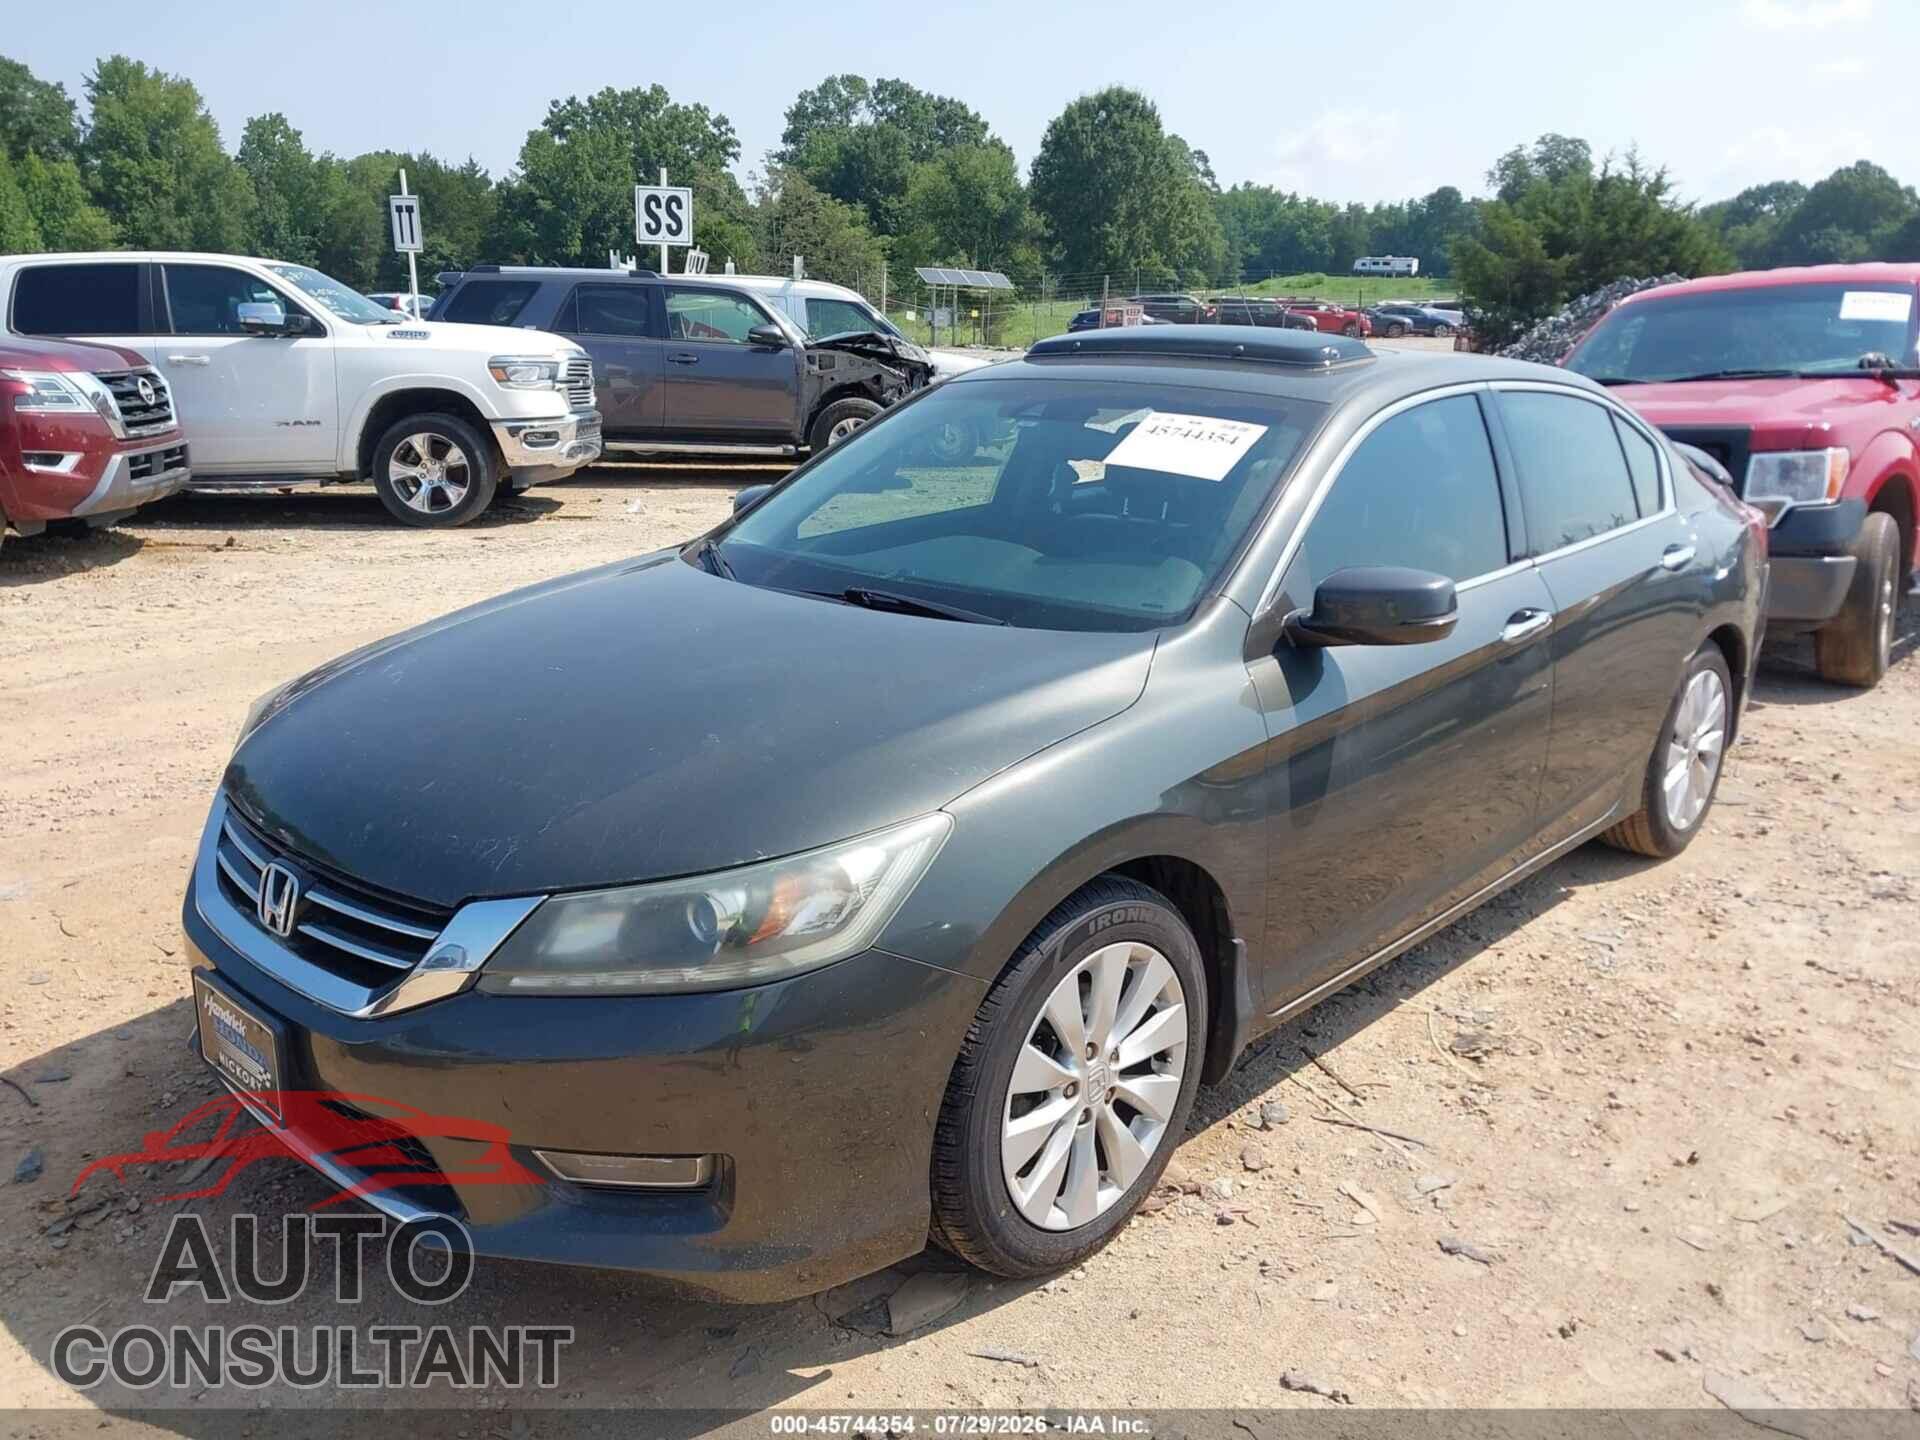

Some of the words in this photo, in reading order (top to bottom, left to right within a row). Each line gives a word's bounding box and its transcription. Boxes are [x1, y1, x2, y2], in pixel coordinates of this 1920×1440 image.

[644, 193, 683, 237] SS
[203, 993, 248, 1037] Hendrick
[218, 1051, 262, 1092] HICKORY
